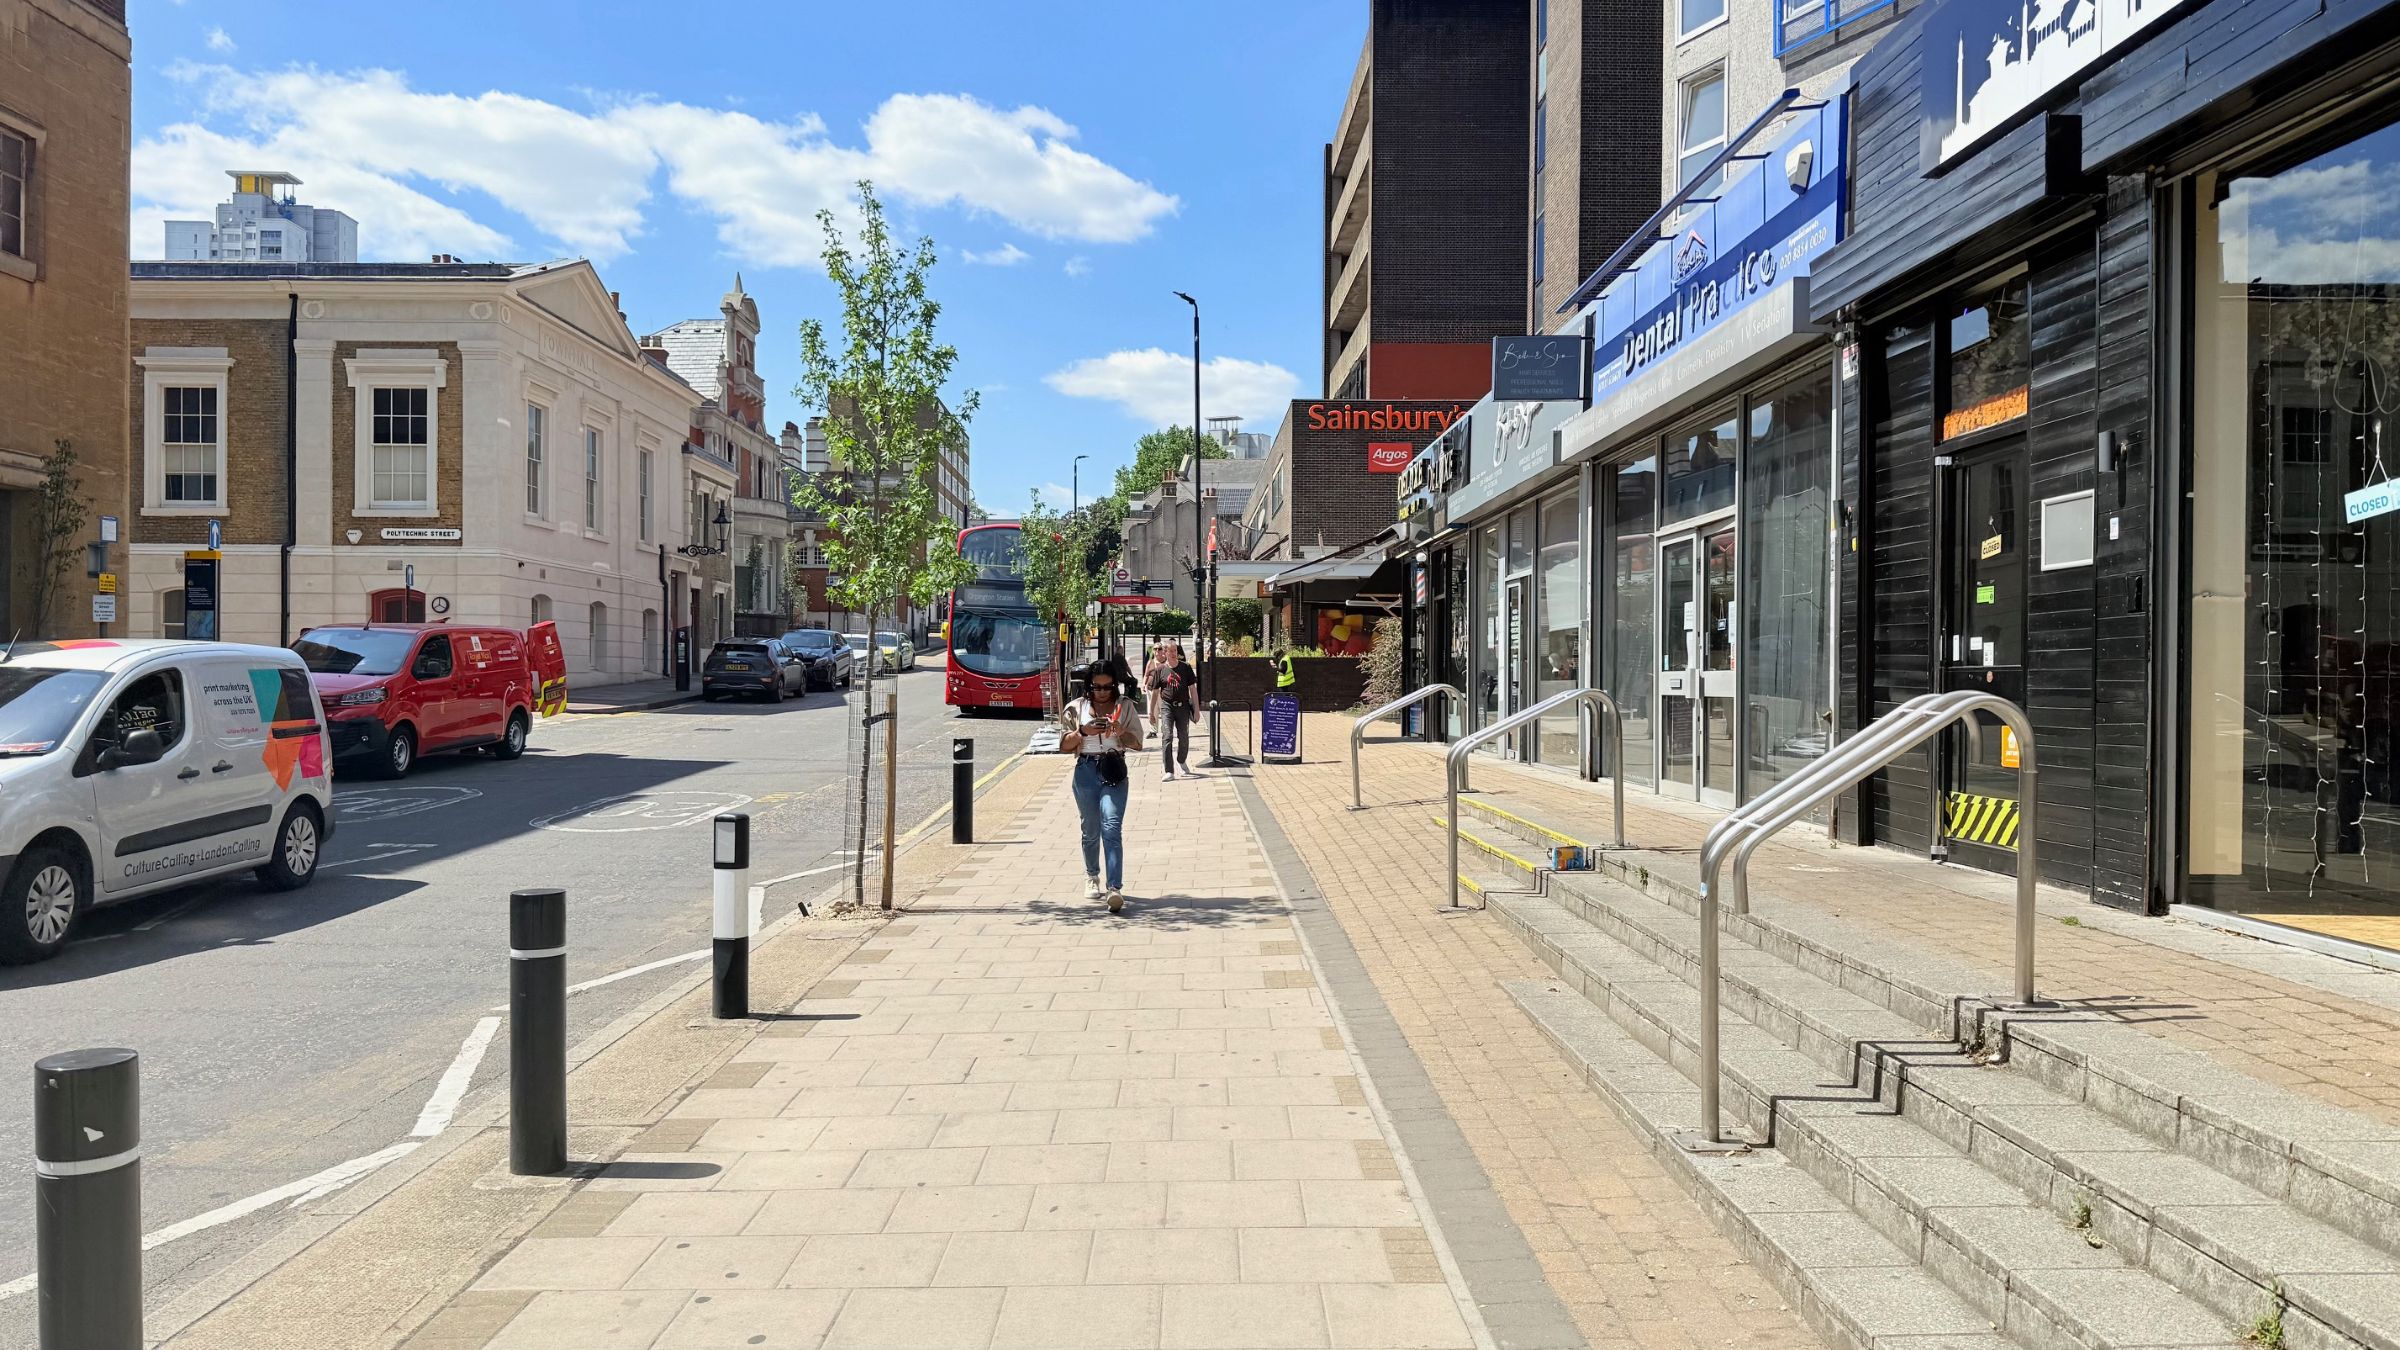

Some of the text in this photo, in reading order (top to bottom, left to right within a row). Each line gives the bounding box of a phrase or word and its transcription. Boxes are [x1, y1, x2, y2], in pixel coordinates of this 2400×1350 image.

[1752, 305, 1785, 337] Sedation
[1624, 290, 1682, 374] Dental
[1705, 338, 1735, 364] Dentistry
[1373, 448, 1408, 462] Argos
[2350, 495, 2389, 516] CLOSED
[1982, 542, 2000, 555] CLOSED
[967, 593, 1016, 602] Orpington Station
[203, 682, 250, 694] print marketing
[233, 696, 243, 705] the
[242, 695, 253, 704] UK
